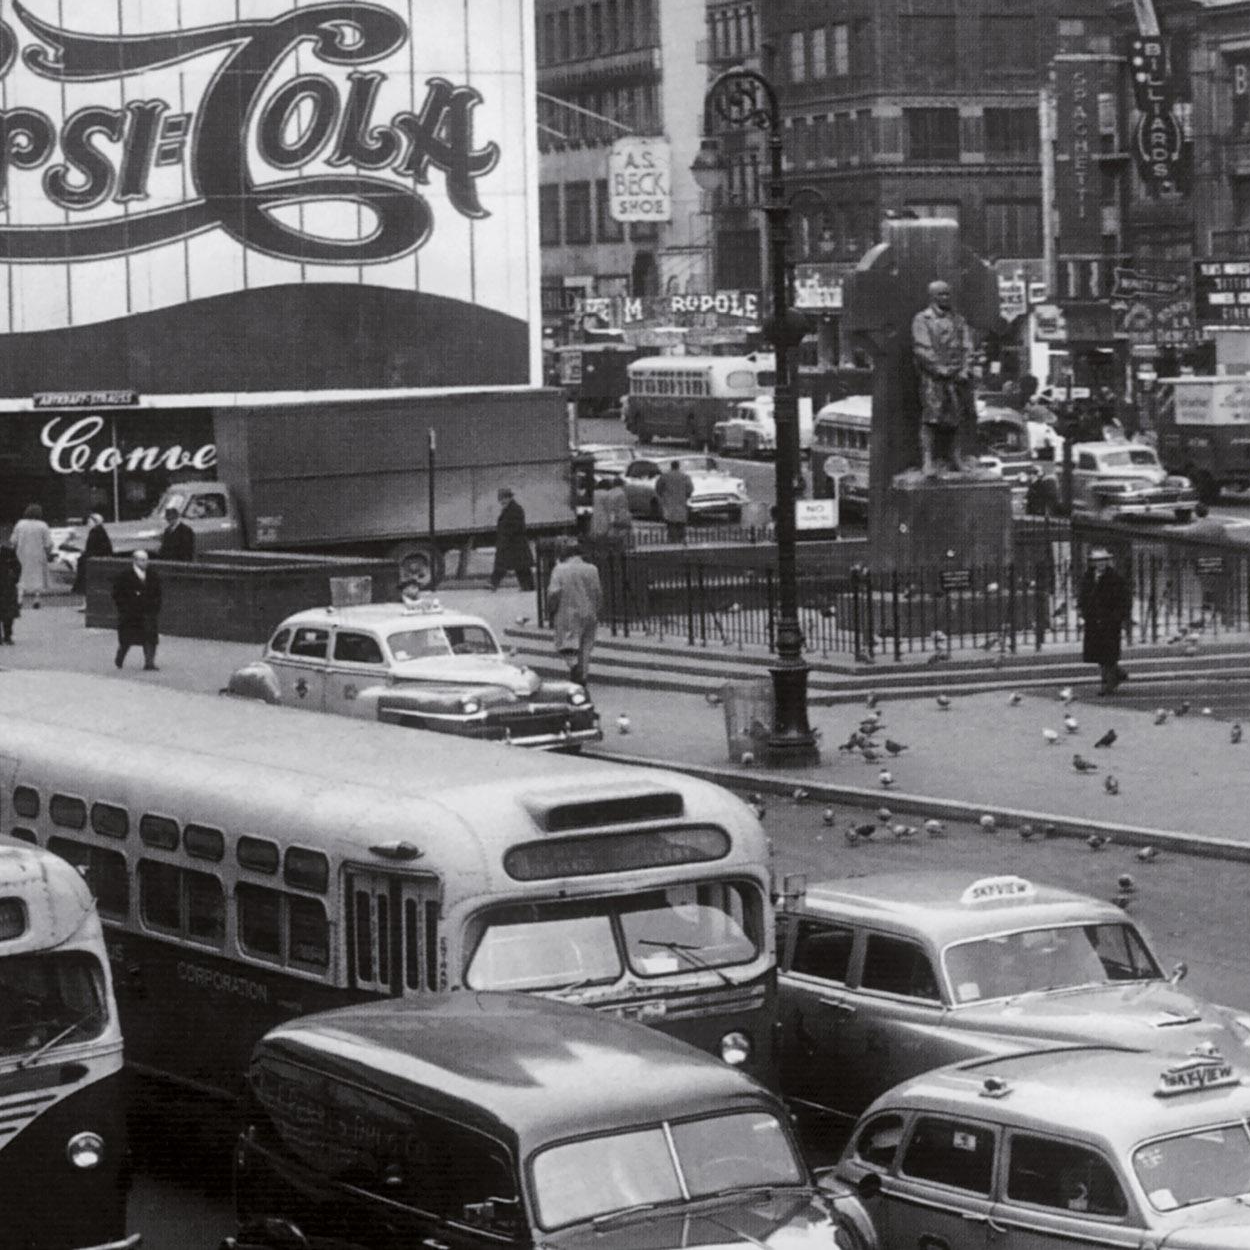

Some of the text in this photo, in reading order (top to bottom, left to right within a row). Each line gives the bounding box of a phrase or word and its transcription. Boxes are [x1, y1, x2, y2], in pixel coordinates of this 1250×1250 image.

[1145, 42, 1170, 178] BILLIARDS
[614, 171, 667, 196] BECK
[618, 198, 664, 214] SHOE
[624, 293, 757, 323] MROPOLE
[176, 960, 268, 1004] CORPORATION
